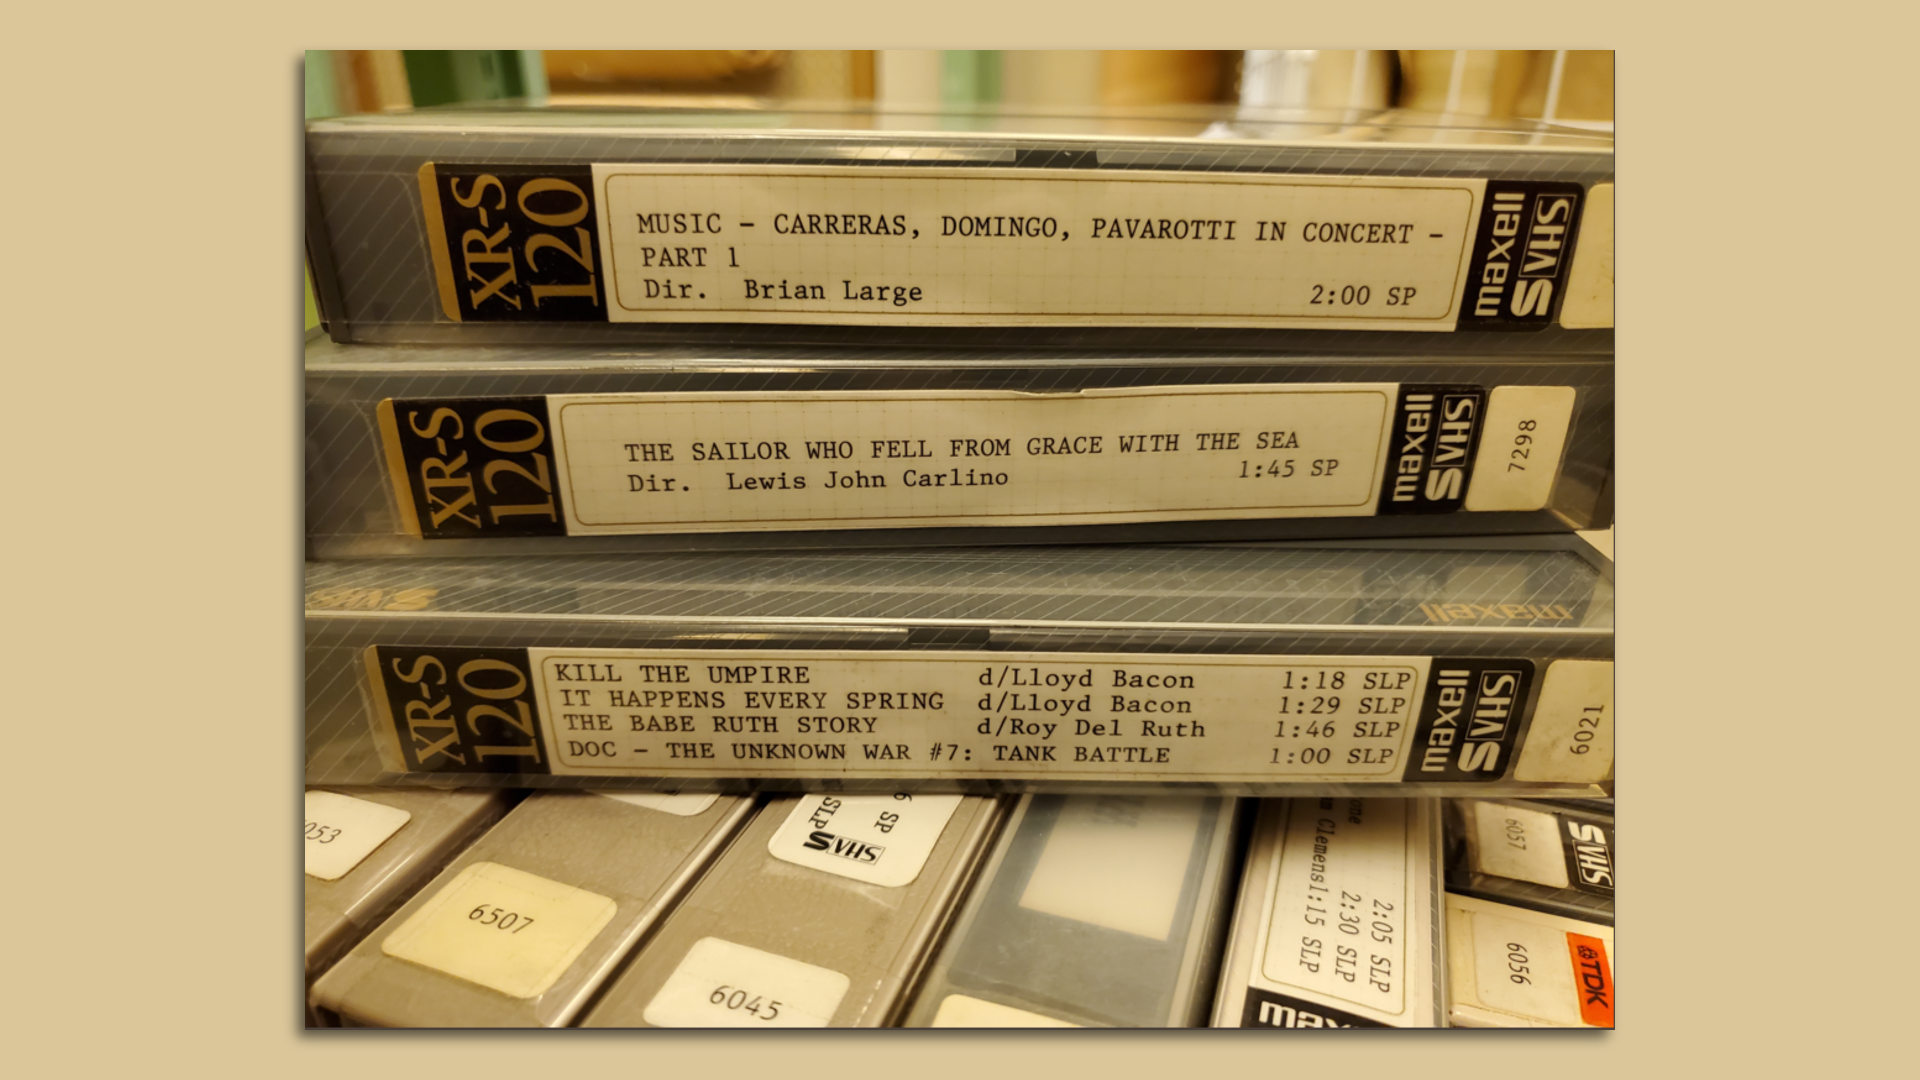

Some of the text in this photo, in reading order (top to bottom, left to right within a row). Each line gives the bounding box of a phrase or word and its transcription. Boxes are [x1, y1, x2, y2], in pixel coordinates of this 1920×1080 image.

[451, 174, 521, 311] XR-S
[517, 177, 599, 307] 120
[636, 212, 722, 234] MUSIC
[773, 213, 920, 240] CARRERAS,
[940, 215, 1070, 242] DOMINGO,
[1090, 217, 1237, 241] PAVAROTTI
[1254, 220, 1287, 242] IN
[1302, 221, 1414, 244] CONCERT
[640, 246, 740, 268] PART 1
[1474, 192, 1526, 316] maxell
[643, 278, 1417, 307] Dir. Brian Large 2:00 SP
[623, 431, 1300, 463] THE SAILOR WHO FELL FROM GRACE WITH THE SEA
[1392, 394, 1435, 502] maxell
[1506, 418, 1538, 473] 7298
[408, 407, 482, 529] XR-S
[474, 408, 557, 525] 120
[626, 458, 1339, 493] Dir. Lewis John Carlino 1:45 SP
[1419, 603, 1574, 623] maxell
[554, 663, 1412, 693] KILL THE UMPIRE d/Lloyd Bacon 1:18 SLP
[392, 654, 467, 766] XR-S
[456, 658, 541, 764] 120
[559, 688, 1406, 717] IT HAPPENS EVERY SPRING d/Lloyd Bacon 1:29 SLP
[1421, 670, 1471, 772] maxell
[562, 713, 1401, 741] THE BABE RUTH STORY d/Roy Del Ruth 1:46 SLP
[1569, 704, 1605, 756] 6021
[567, 740, 617, 758] DOC
[665, 742, 716, 759] THE
[730, 742, 846, 760] UNKNOWN
[862, 743, 912, 760] WAR
[929, 742, 972, 762] #7:
[992, 744, 1057, 762] TANK
[1073, 746, 1171, 764] BATTLE
[1270, 747, 1332, 765] 1:00
[1346, 747, 1394, 765] SLP
[304, 820, 342, 844] 053
[808, 796, 842, 830] SLP
[873, 811, 900, 834] SP
[1505, 817, 1527, 851] 6057
[468, 903, 535, 935] 6507
[1338, 890, 1362, 936] 2:30
[1300, 935, 1323, 974] SLP
[1335, 945, 1358, 984] SLP
[1369, 898, 1395, 994] 2:05 SLP
[1505, 941, 1532, 986] 6056
[709, 984, 783, 1021] 6045
[1581, 959, 1609, 1010] TDK
